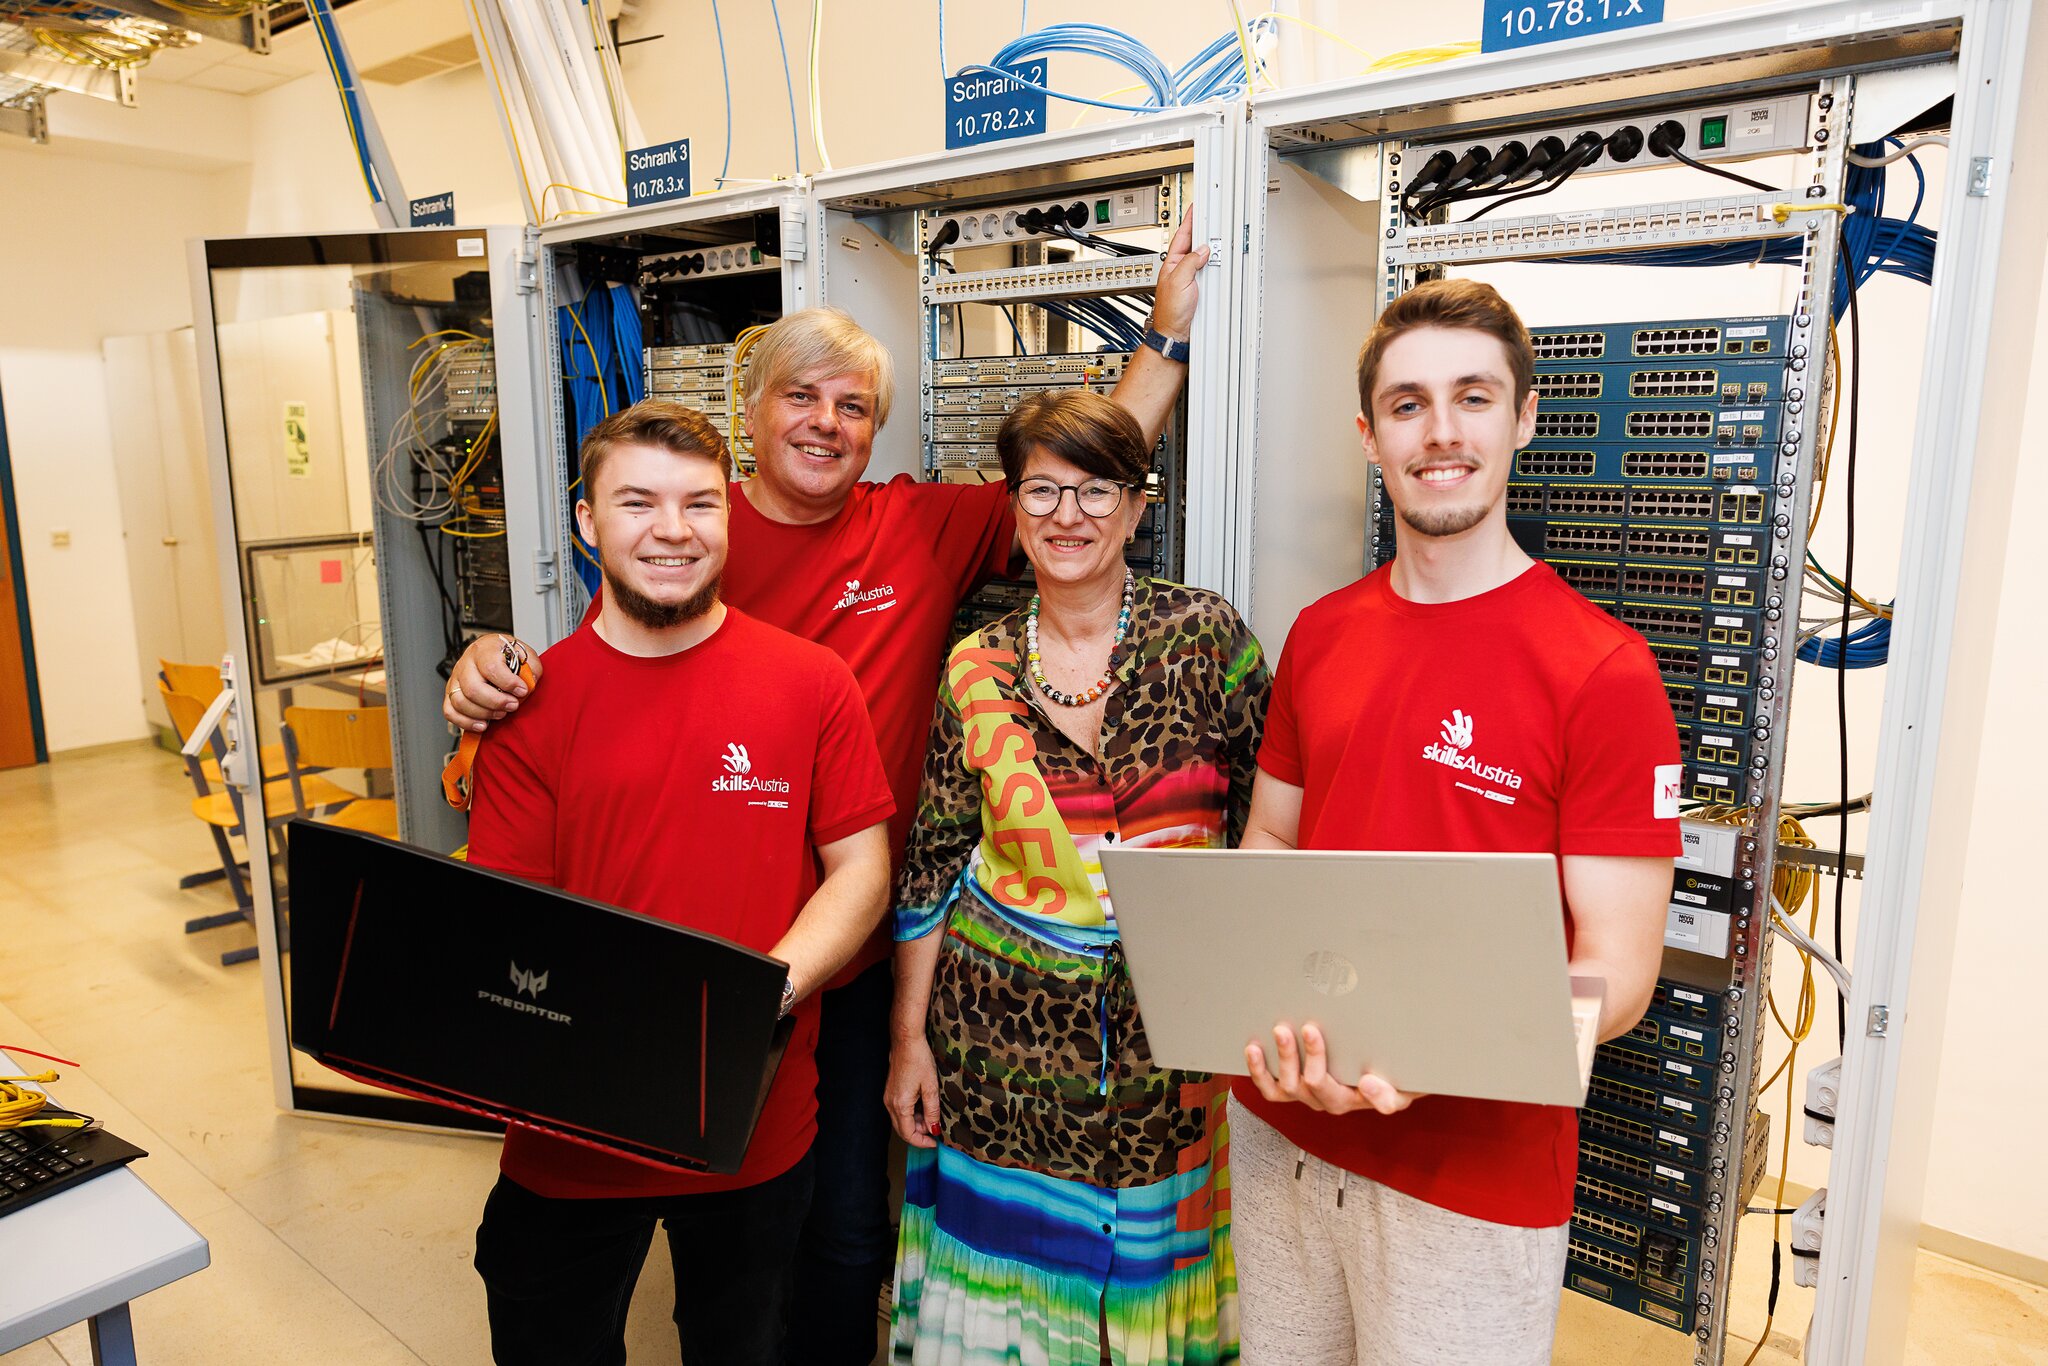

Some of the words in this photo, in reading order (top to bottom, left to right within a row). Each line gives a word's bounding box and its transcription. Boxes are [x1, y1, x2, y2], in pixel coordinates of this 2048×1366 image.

[1501, 0, 1643, 38] 10.78.1.x
[953, 70, 1025, 103] Schrank
[1030, 66, 1042, 87] 2
[955, 108, 1036, 138] 10.78.2.x
[630, 148, 678, 172] Schrank
[679, 144, 688, 162] 3
[632, 176, 684, 200] 10.78.3.x
[412, 196, 445, 218] Schrank
[445, 192, 453, 210] 4
[1422, 742, 1522, 789] skillsAustria
[712, 775, 790, 793] skillsAustria
[948, 647, 1067, 915] KISSES
[1697, 882, 1722, 892] perle
[478, 990, 572, 1026] PREDATOR
